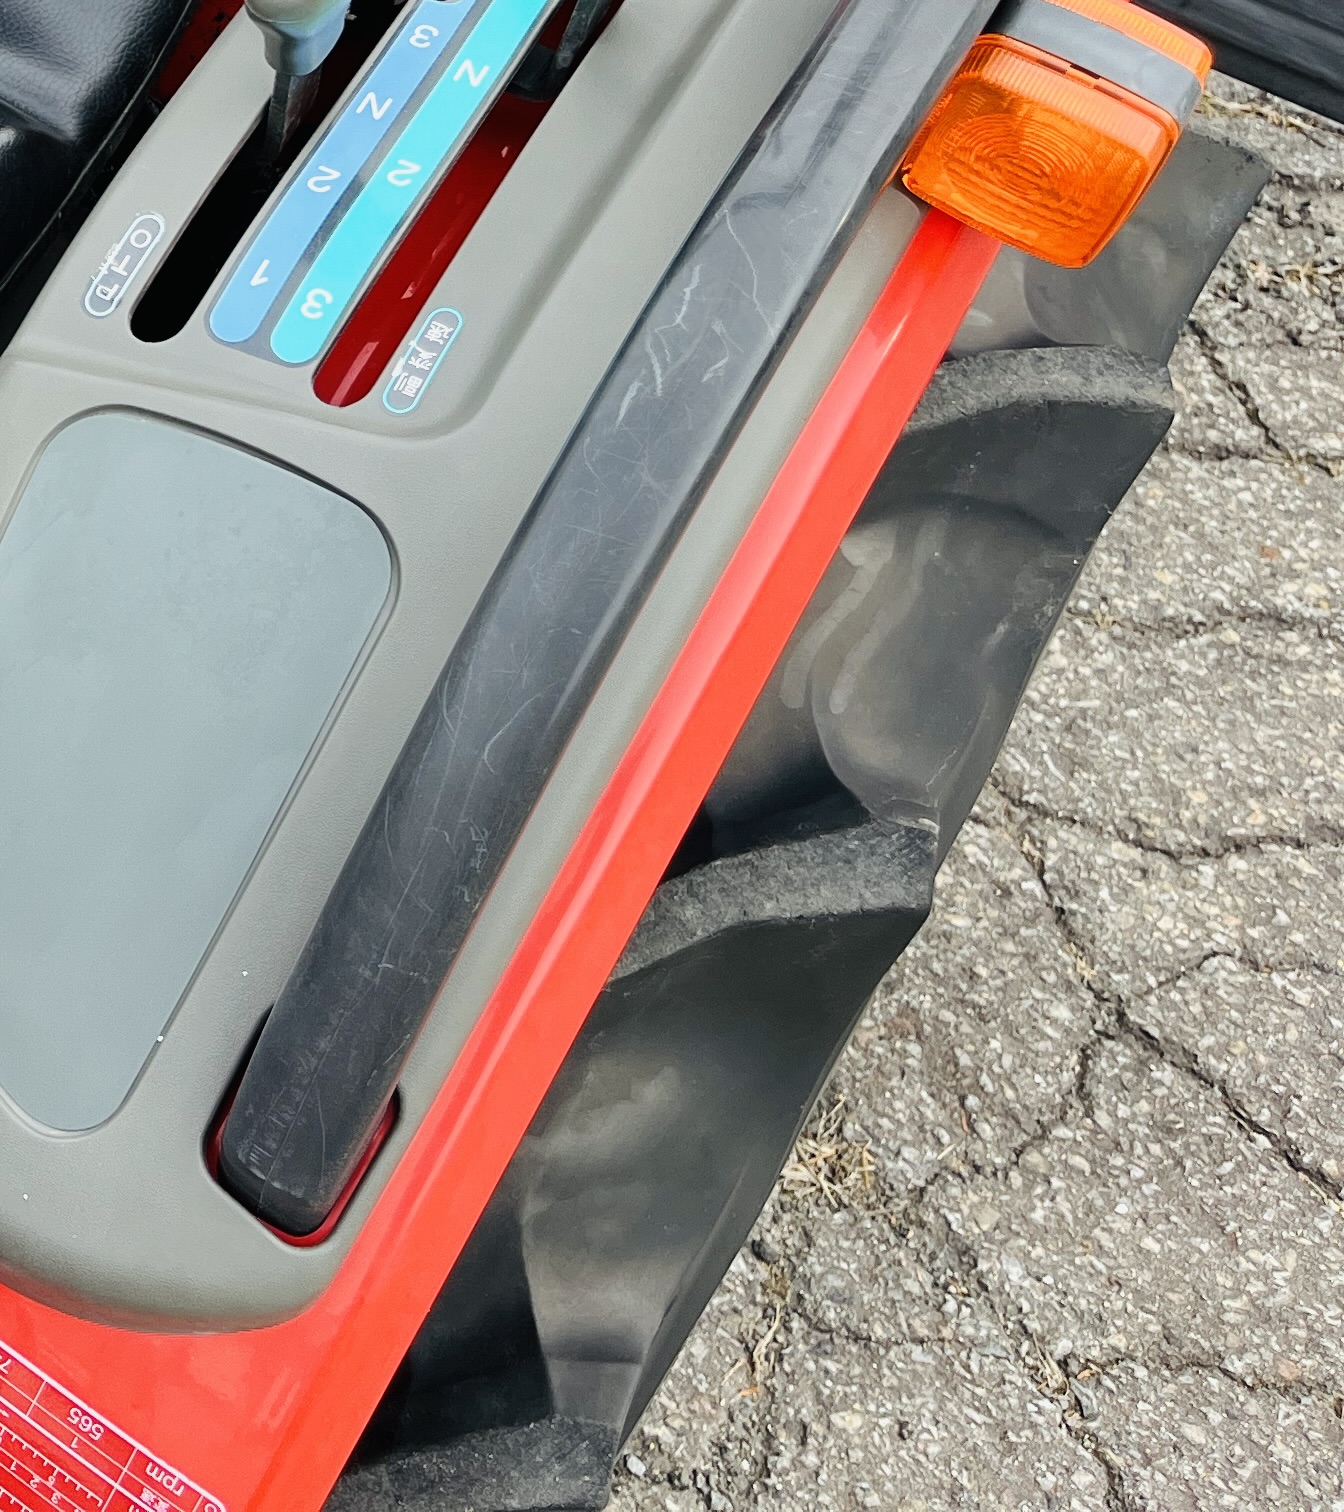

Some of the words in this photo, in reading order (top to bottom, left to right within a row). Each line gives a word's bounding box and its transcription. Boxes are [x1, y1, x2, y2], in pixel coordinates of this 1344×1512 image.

[410, 24, 440, 51] 3
[452, 58, 490, 90] N
[356, 90, 393, 121] N
[307, 165, 342, 194] 2
[387, 158, 421, 188] 2
[95, 226, 152, 304] PTO
[249, 257, 274, 287] 1
[300, 288, 334, 320] 3
[394, 317, 456, 400] 副変速
[67, 1407, 106, 1442] 565
[145, 1462, 186, 1497] rpm
